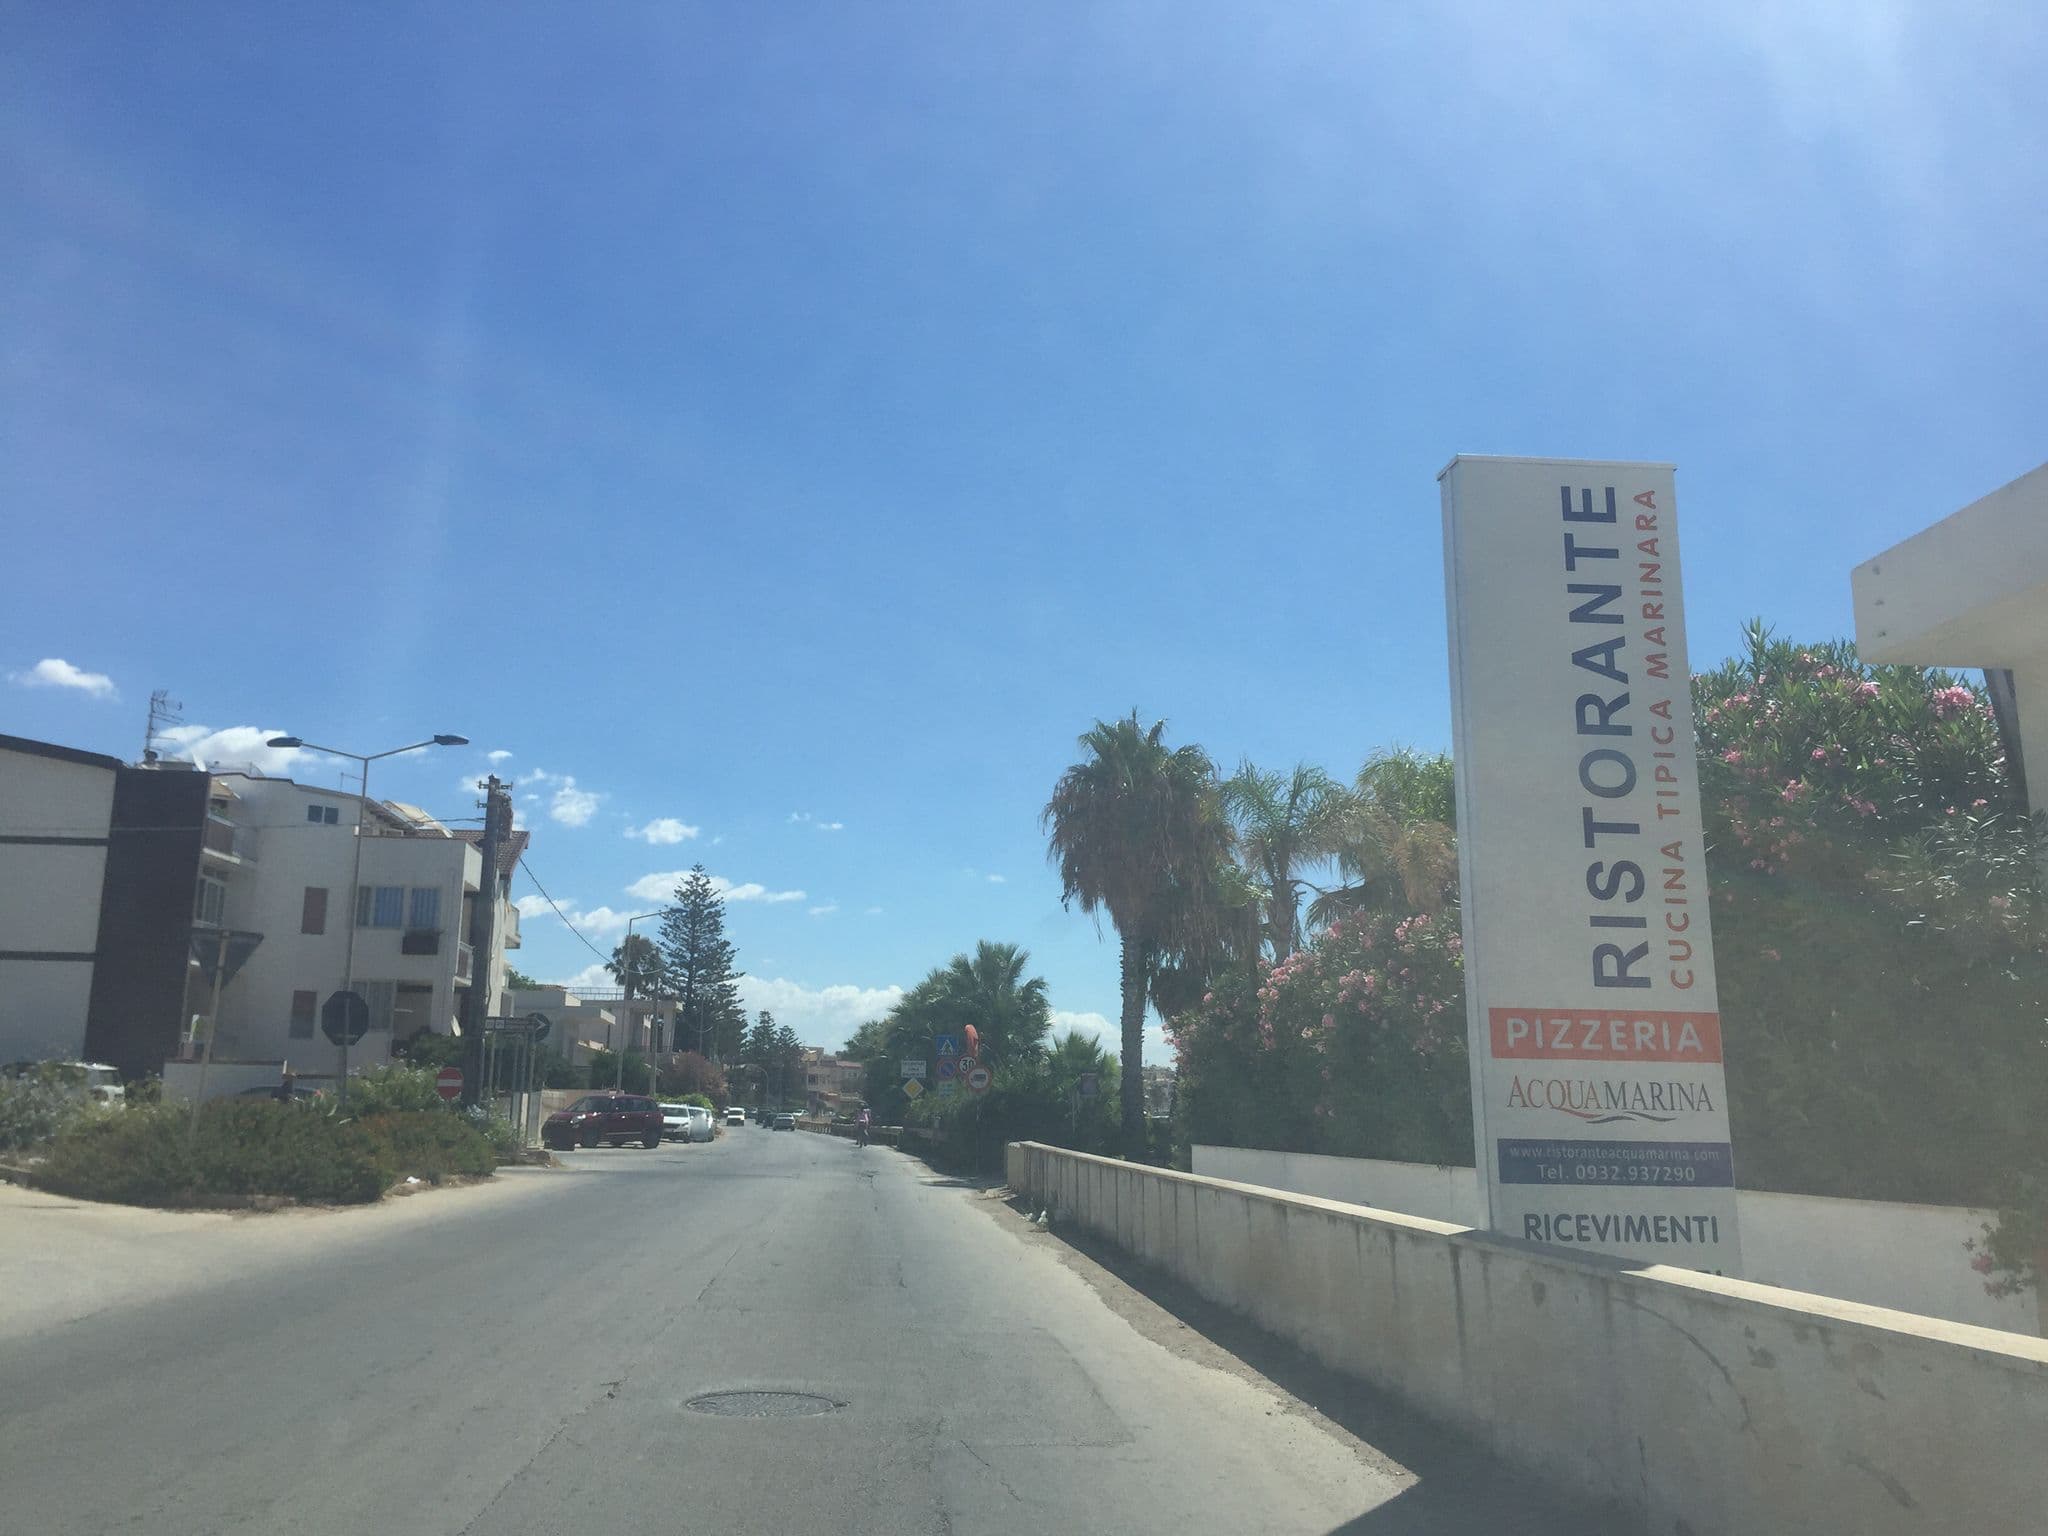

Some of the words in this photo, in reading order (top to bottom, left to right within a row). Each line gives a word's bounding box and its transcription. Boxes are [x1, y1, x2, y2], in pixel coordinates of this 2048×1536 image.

[1633, 489, 1670, 679] MARINARA
[1560, 486, 1652, 989] RISTORANTE
[1649, 700, 1681, 820] TIPICA
[1660, 841, 1694, 989] CUCINA
[1507, 1017, 1703, 1053] PIZZERIA
[960, 1059, 975, 1072] 30
[1507, 1075, 1715, 1112] ACQUAMARINA
[1510, 1145, 1720, 1162] www.ristoranteacquamarina.com
[1537, 1164, 1568, 1180] Tel.
[1576, 1164, 1696, 1182] 0932.937290
[1524, 1213, 1718, 1244] RICEVIMENTI
